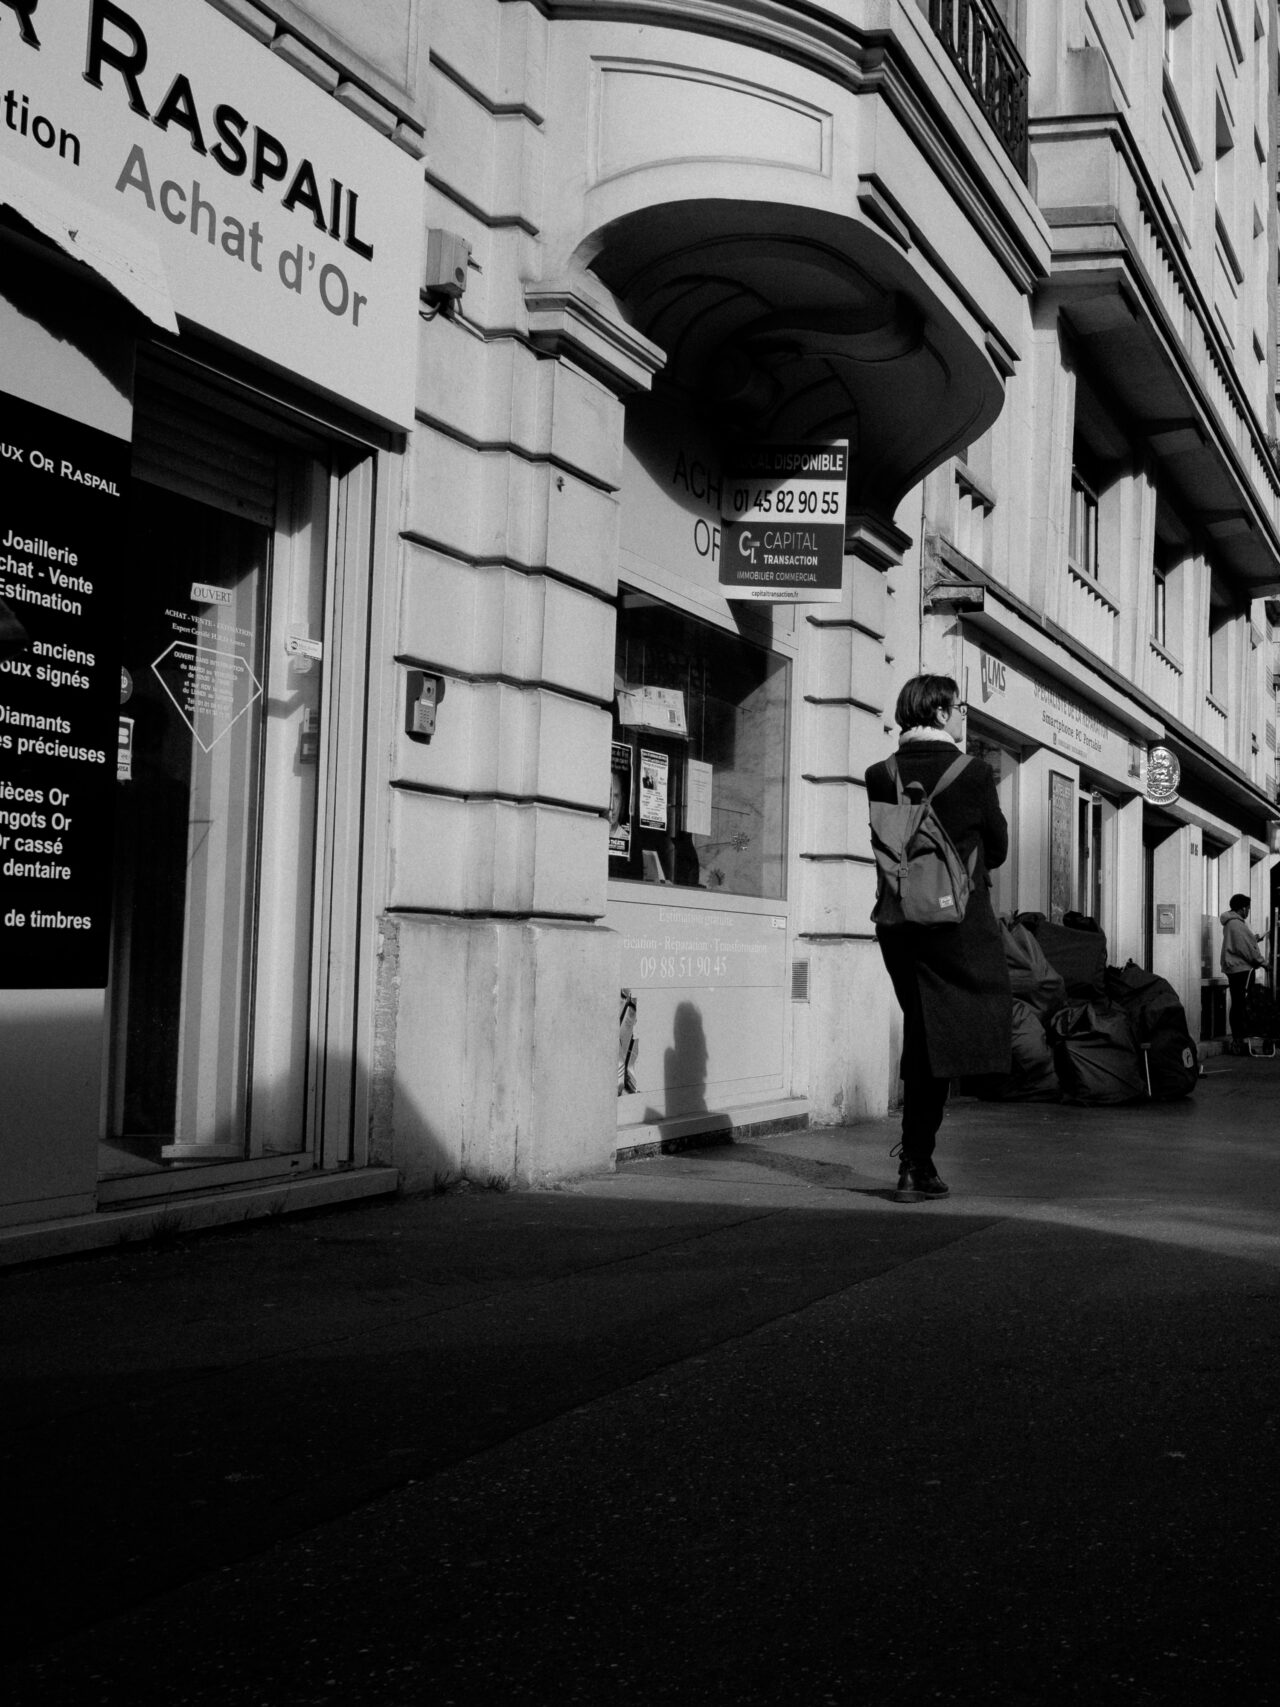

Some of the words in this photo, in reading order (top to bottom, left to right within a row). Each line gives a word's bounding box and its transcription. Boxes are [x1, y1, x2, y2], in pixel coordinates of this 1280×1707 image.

[82, 0, 374, 261] RASPAIL
[115, 143, 263, 272] Achat
[279, 243, 367, 327] d'Or
[774, 453, 844, 471] DISPONIBLE
[734, 490, 749, 512] 01
[753, 490, 771, 512] 45
[776, 490, 794, 513] 82
[798, 491, 817, 513] 90
[821, 492, 839, 514] 55
[2, 530, 78, 566] Joaillerie
[764, 531, 818, 550] CAPITAL
[763, 555, 818, 566] TRANSACTION
[49, 567, 93, 595] Vente
[737, 571, 774, 581] IMMOBILIER
[775, 572, 817, 582] COMMERCIAL
[193, 586, 232, 602] OUVERT
[165, 608, 187, 619] ACHAT
[32, 640, 95, 666] anciens
[36, 664, 90, 690] signés
[17, 736, 105, 763] précieuses
[49, 788, 69, 806] Or
[51, 813, 72, 830] Or
[14, 837, 63, 855] cassé
[3, 858, 71, 880] dentaire
[4, 909, 25, 927] de
[30, 910, 92, 929] timbres
[640, 956, 656, 979] 09
[660, 956, 676, 978] 88
[679, 956, 692, 978] 51
[697, 955, 711, 977] 90
[714, 955, 727, 977] 45
